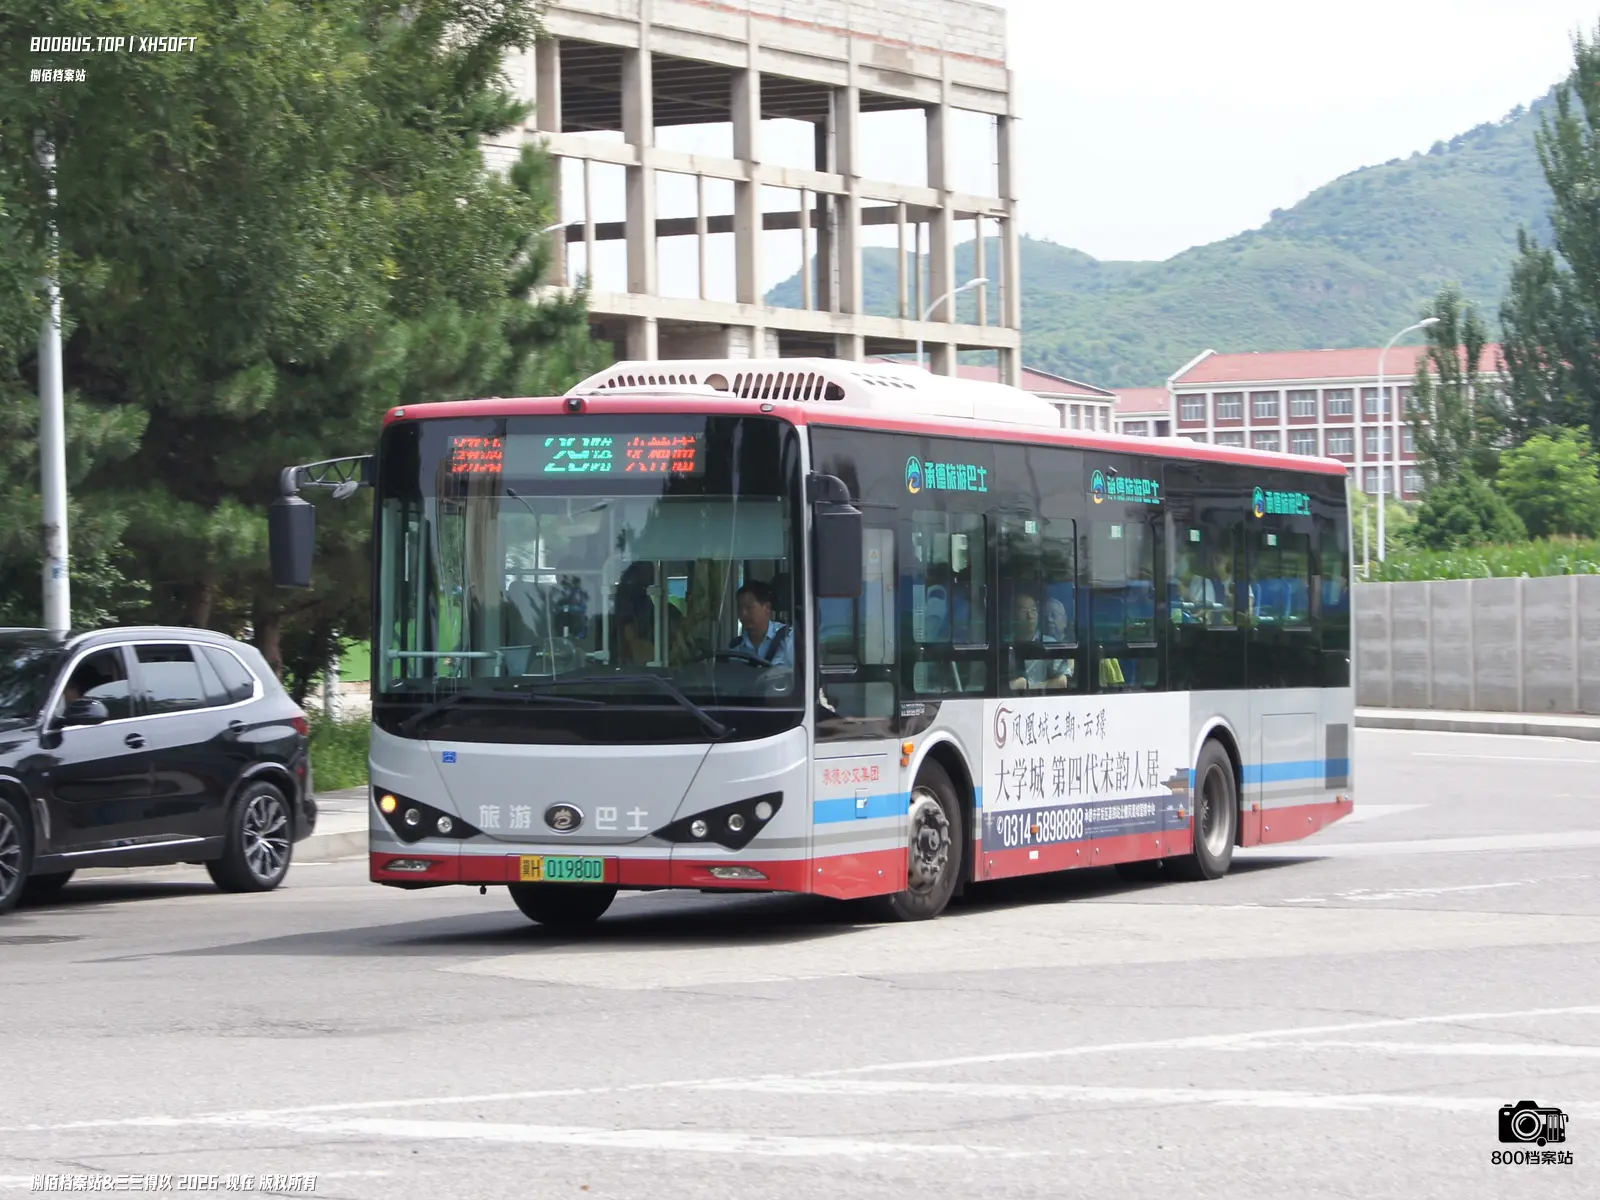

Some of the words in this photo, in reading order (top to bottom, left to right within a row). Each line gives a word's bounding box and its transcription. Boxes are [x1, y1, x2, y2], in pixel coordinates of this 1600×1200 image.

[924, 462, 988, 492] 承德旅游巴士
[994, 757, 1045, 803] 大学城
[1052, 749, 1159, 798] 第四代宋韵人居
[478, 804, 532, 830] 旅游
[595, 806, 649, 832] 巴士
